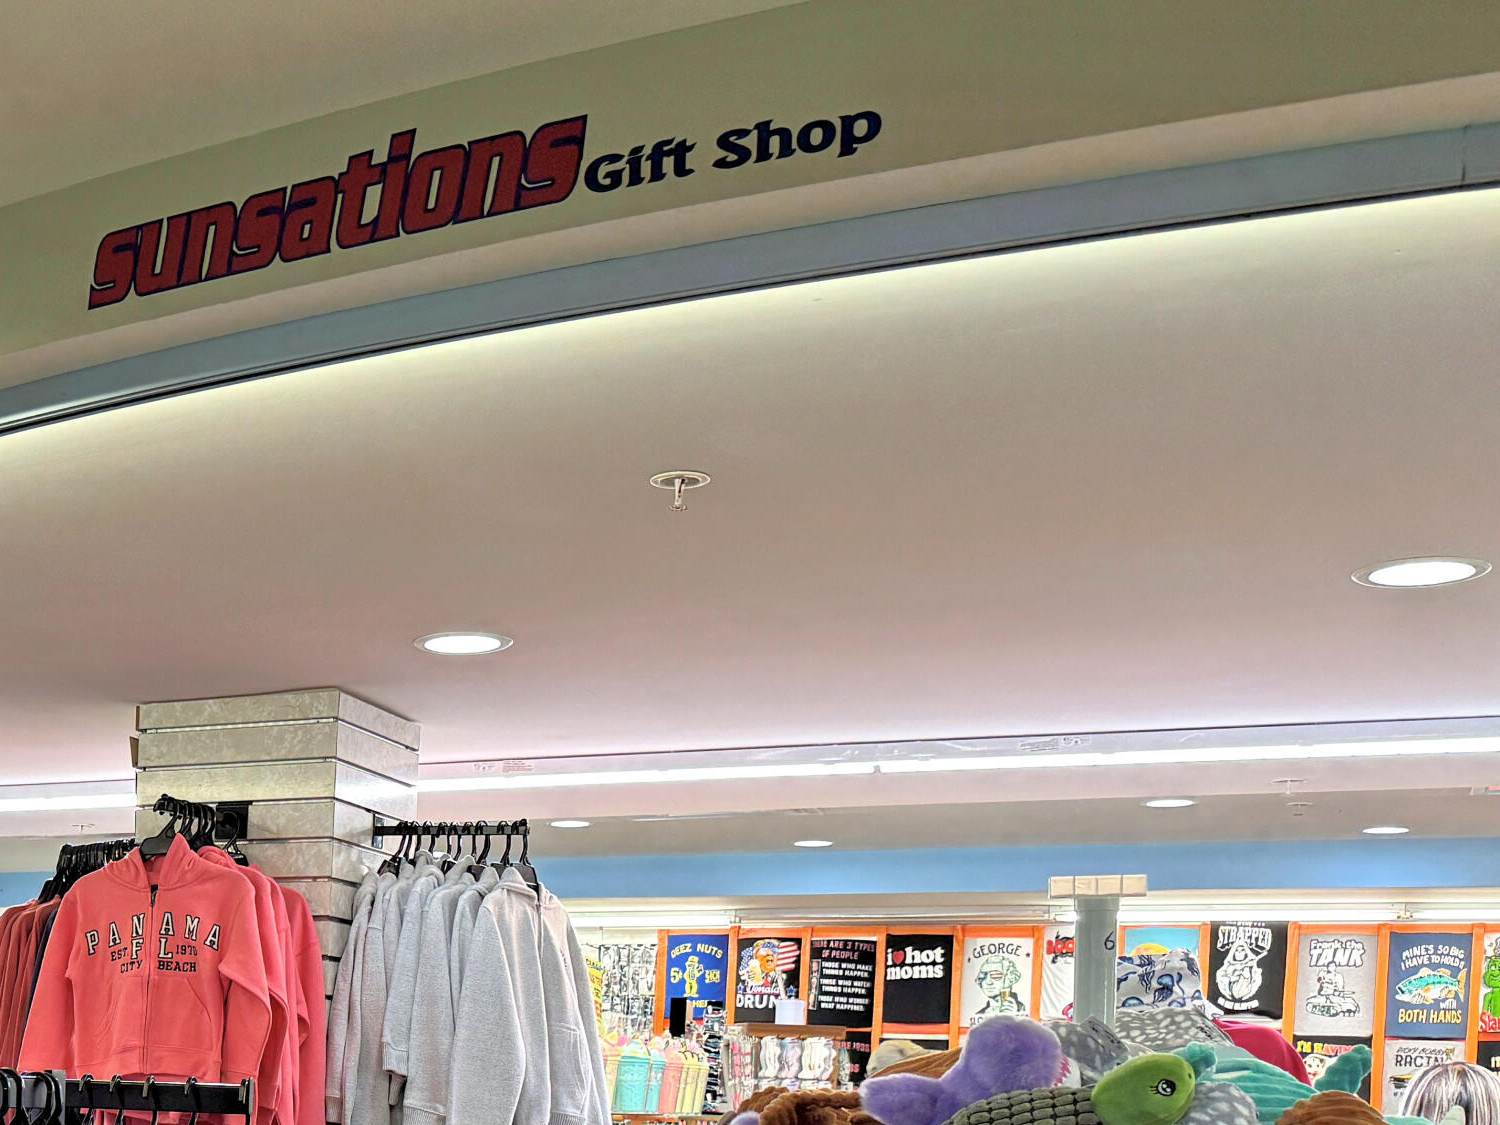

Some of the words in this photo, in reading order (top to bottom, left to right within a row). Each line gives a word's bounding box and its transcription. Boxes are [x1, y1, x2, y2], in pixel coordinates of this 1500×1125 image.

[88, 115, 588, 310] sunsations
[584, 137, 695, 192] Gift
[713, 110, 881, 169] Shop
[85, 912, 221, 956] PANAMA
[671, 943, 692, 958] DEEZ
[697, 943, 723, 959] NUTS
[829, 941, 844, 949] ARE
[972, 942, 1022, 959] GEORGE
[1310, 939, 1342, 950] Frank
[1346, 939, 1364, 950] the
[1402, 944, 1434, 960] MINE'S
[1437, 945, 1448, 954] SO
[1449, 946, 1465, 958] BIG
[831, 950, 859, 960] PEOPLE
[904, 946, 945, 964] hot
[1309, 948, 1366, 968] TANK
[1405, 955, 1430, 969] HAVE
[1431, 955, 1440, 964] TO
[1440, 956, 1460, 967] HOLD
[120, 960, 143, 974] CITY
[158, 960, 196, 973] BEACH
[886, 963, 944, 981] moms
[1440, 998, 1457, 1009] WITH
[1398, 1009, 1427, 1024] BOTH
[1430, 1009, 1462, 1024] HANDS
